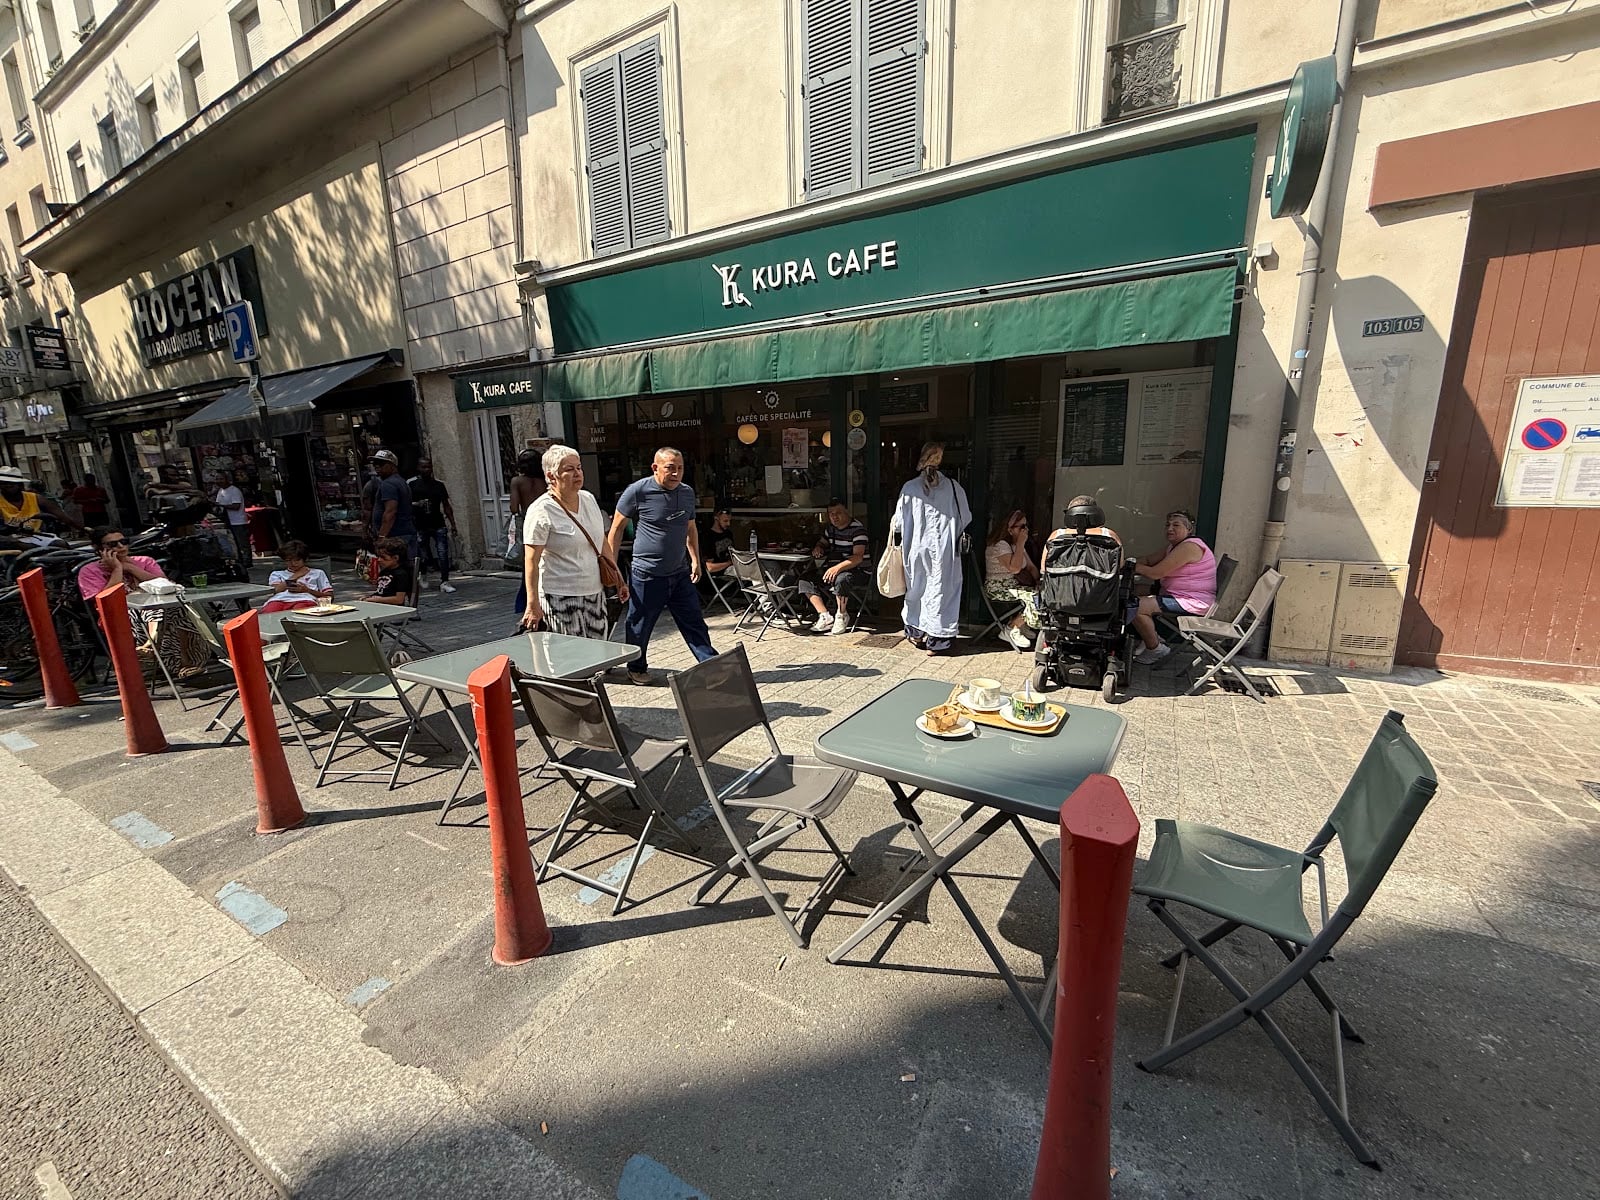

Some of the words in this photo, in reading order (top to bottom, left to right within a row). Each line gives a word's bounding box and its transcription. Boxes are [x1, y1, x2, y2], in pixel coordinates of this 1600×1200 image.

[752, 258, 817, 292] KURA
[827, 240, 897, 278] CAFE
[133, 257, 242, 339] HOCEAN
[227, 311, 242, 353] P
[1366, 321, 1390, 335] 103
[1396, 318, 1421, 332] 105
[145, 328, 203, 360] MAROQUINERIE
[483, 385, 507, 398] KURA
[509, 380, 533, 394] CAFE
[590, 426, 605, 434] TAKE
[736, 413, 758, 423] CAFÉS
[759, 413, 769, 422] DE
